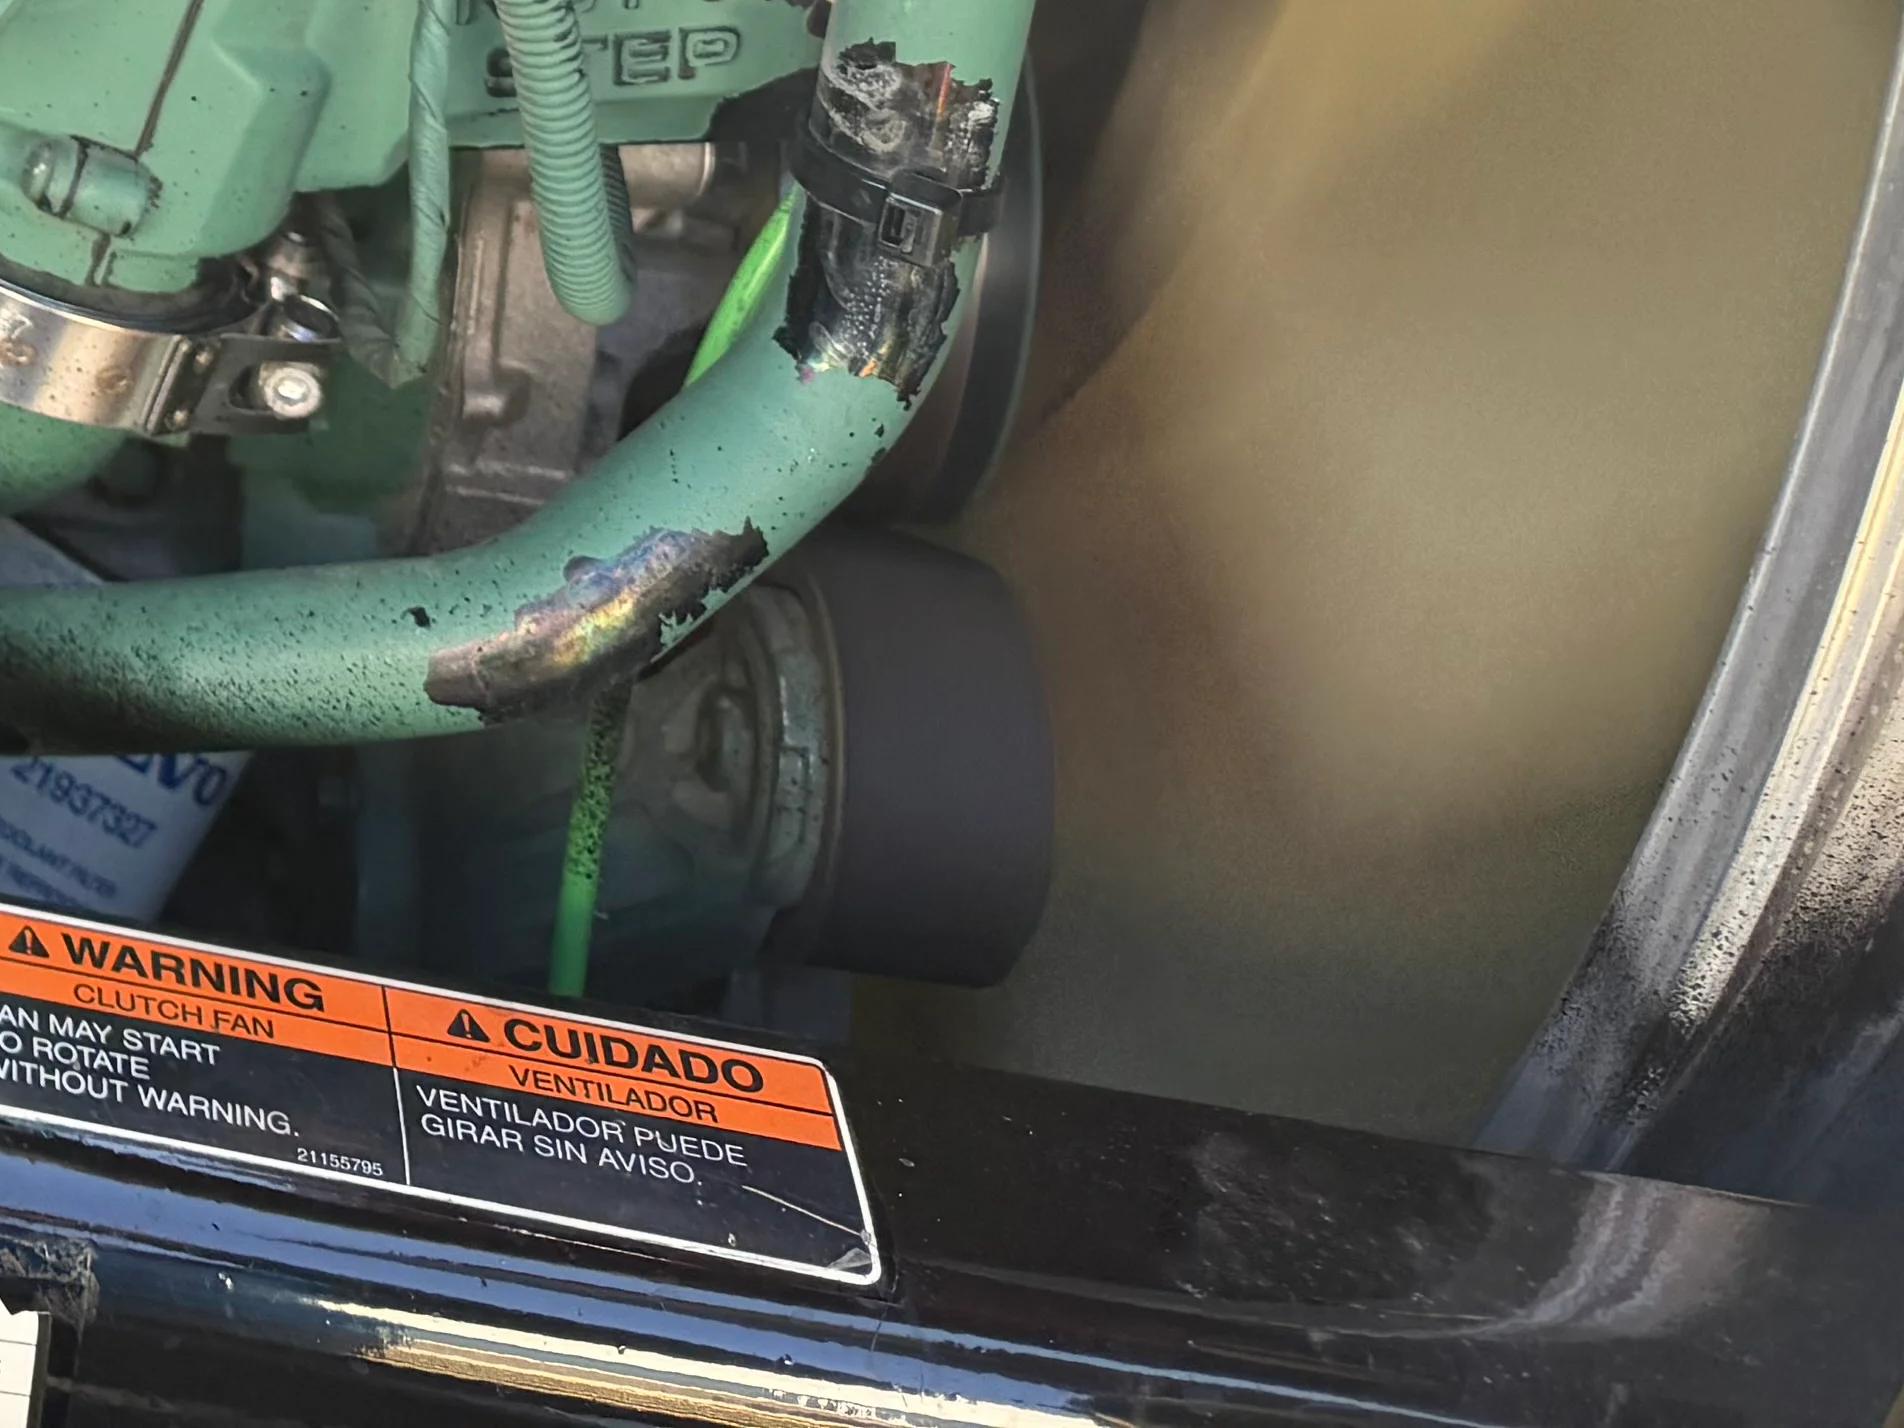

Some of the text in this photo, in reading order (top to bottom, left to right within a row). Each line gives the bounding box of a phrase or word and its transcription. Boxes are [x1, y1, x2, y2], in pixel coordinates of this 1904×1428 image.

[60, 932, 326, 1013] WARNING
[48, 1013, 113, 1045] MAY
[122, 1030, 221, 1067] START
[72, 982, 275, 1040] CLUTCH FAN
[31, 1036, 152, 1081] ROTATE
[502, 1017, 765, 1094] CUIDADO
[136, 1088, 302, 1139] WARNING.
[507, 1063, 721, 1124] VENTILADOR
[415, 1084, 749, 1167] VENTILADOR PUEDE
[420, 1113, 703, 1187] GIRAR SIN AVISO.
[296, 1147, 384, 1178] 21155795
